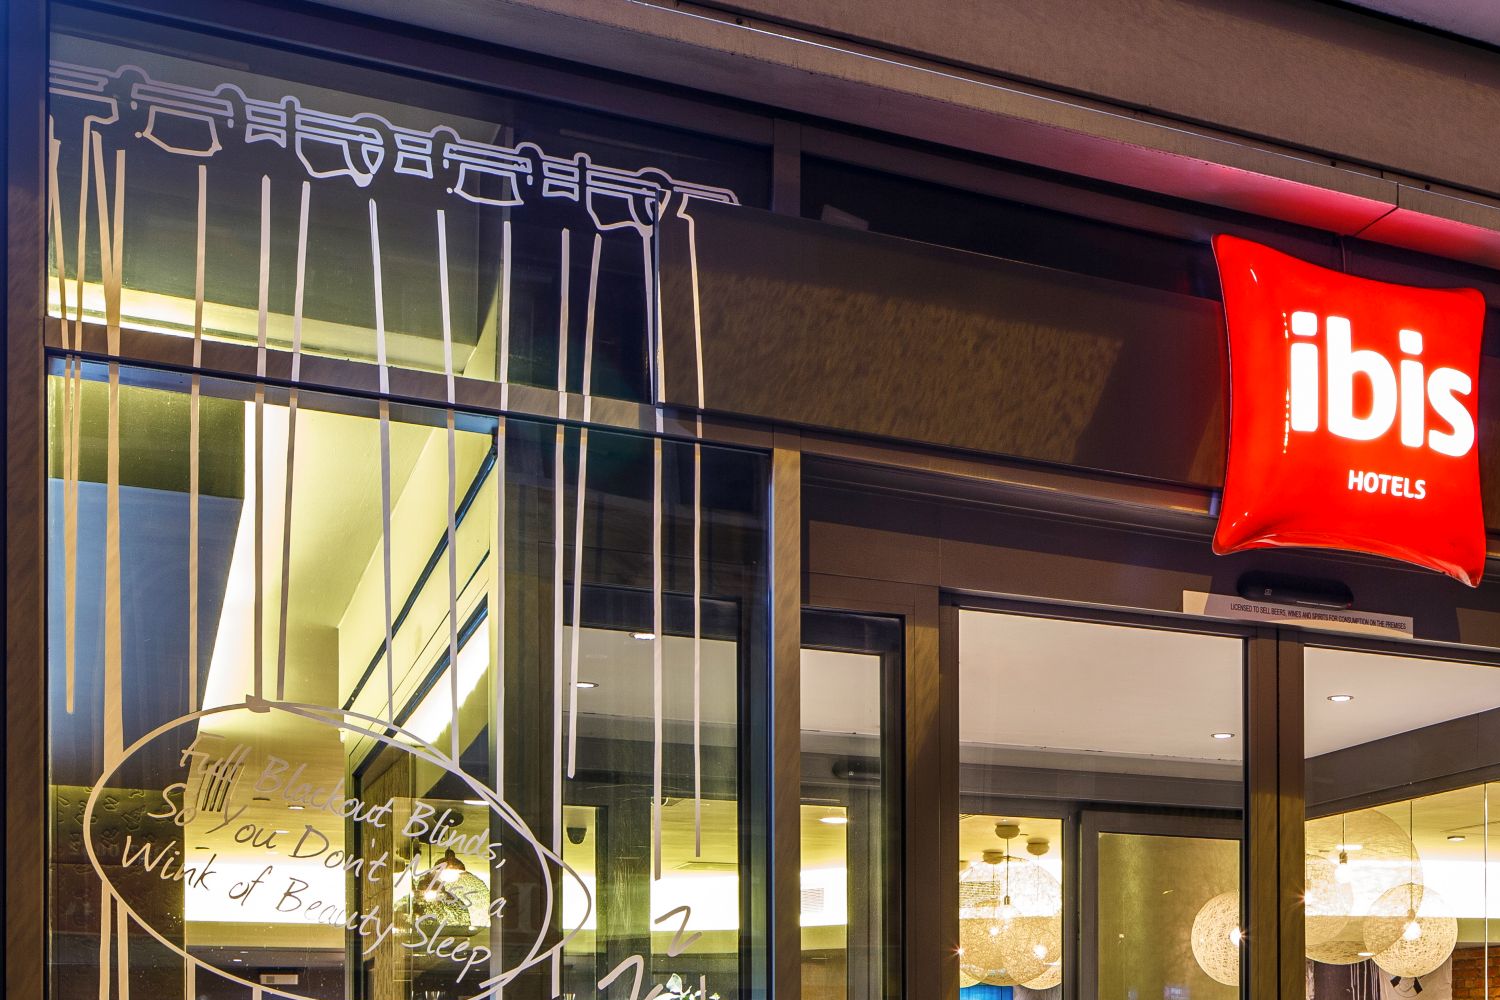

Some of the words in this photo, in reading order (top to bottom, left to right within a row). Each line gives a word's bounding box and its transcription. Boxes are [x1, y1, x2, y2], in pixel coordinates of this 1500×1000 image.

[1290, 311, 1475, 457] ibis
[1347, 469, 1426, 500] HOTELS
[1230, 603, 1252, 612] LICENSED
[1260, 606, 1270, 614] SELL
[1302, 611, 1311, 619] AND
[1312, 612, 1328, 621] SPIRITS
[1339, 615, 1369, 625] CONSUMPTION
[1377, 619, 1385, 627] THE
[1385, 620, 1406, 629] PREMISES
[147, 783, 197, 827] So
[288, 825, 388, 882] Don't
[488, 896, 507, 918] a
[255, 754, 395, 828] Blackout
[402, 801, 506, 868] Blinds,
[122, 835, 217, 891] Wink
[228, 865, 273, 906] of
[276, 877, 394, 956] Beauty
[402, 914, 492, 984] Sleep
